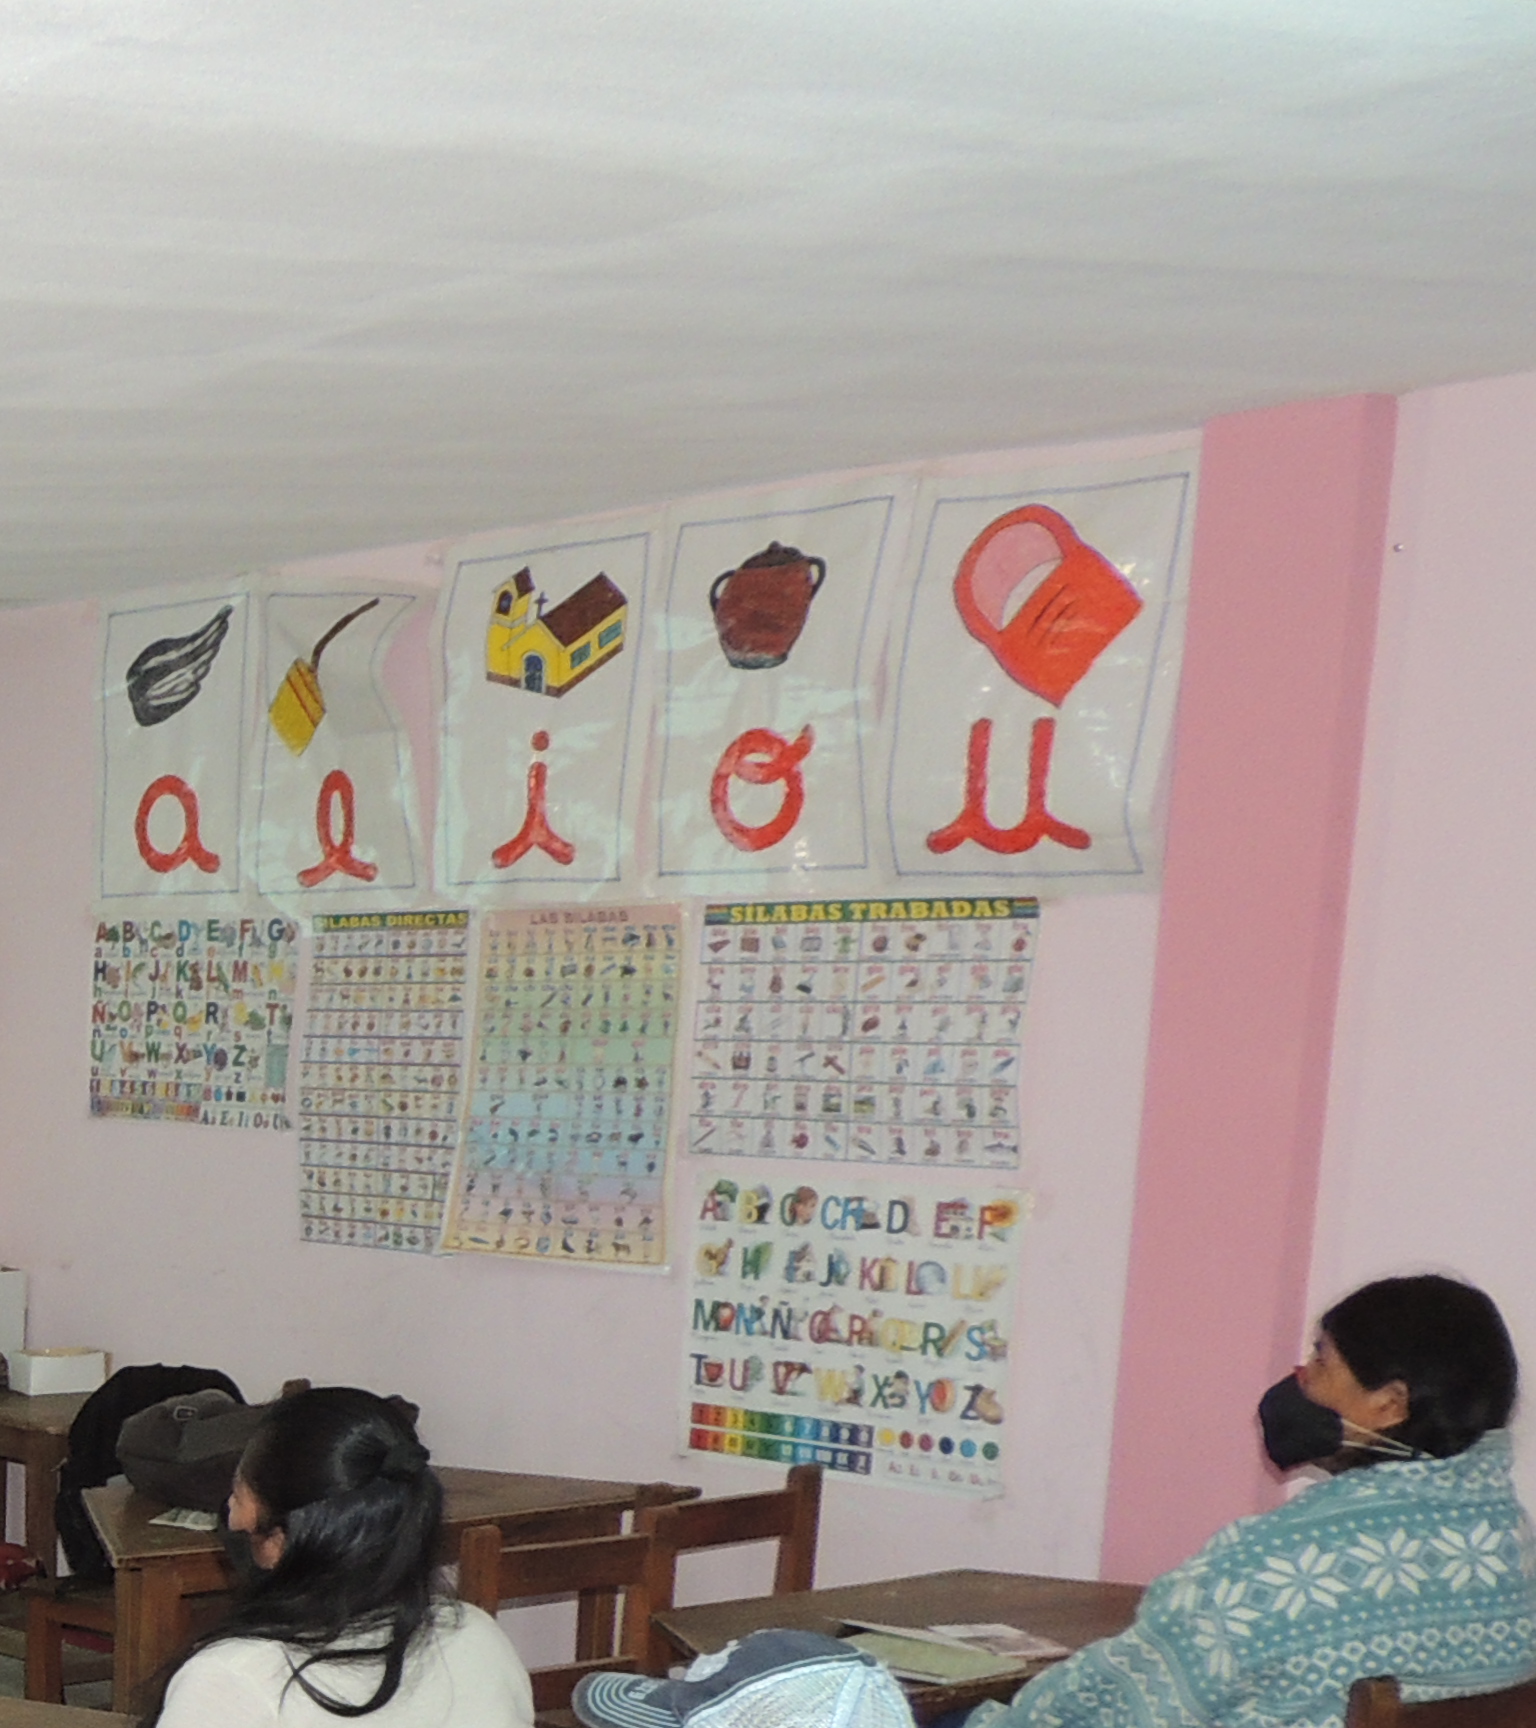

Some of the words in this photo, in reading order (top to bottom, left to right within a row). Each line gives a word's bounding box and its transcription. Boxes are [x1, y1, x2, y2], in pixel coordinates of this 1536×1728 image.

[491, 727, 575, 871] i
[708, 720, 817, 854] o
[925, 716, 1093, 857] u
[134, 774, 223, 875] a
[95, 920, 107, 943] A
[122, 920, 136, 943] B
[178, 919, 192, 943] D
[207, 918, 220, 942] E
[239, 918, 255, 942] F
[267, 917, 285, 942] G
[386, 909, 469, 930] DIRECTAS
[850, 899, 1012, 922] TRABADAS
[93, 960, 108, 983] H
[148, 959, 161, 983] J
[176, 959, 191, 983] K
[207, 959, 220, 983] L
[232, 960, 249, 984] M
[145, 1000, 160, 1023] P
[205, 1001, 220, 1025] R
[265, 1002, 284, 1026] T
[90, 1039, 106, 1063] U
[145, 1041, 161, 1064] W
[173, 1042, 188, 1065] X
[203, 1042, 217, 1066] Y
[232, 1044, 247, 1067] Z
[699, 1188, 723, 1222] A
[886, 1199, 910, 1235] D
[920, 1321, 946, 1358] R
[964, 1324, 990, 1362] S
[688, 1352, 709, 1386] T
[729, 1357, 751, 1392] U
